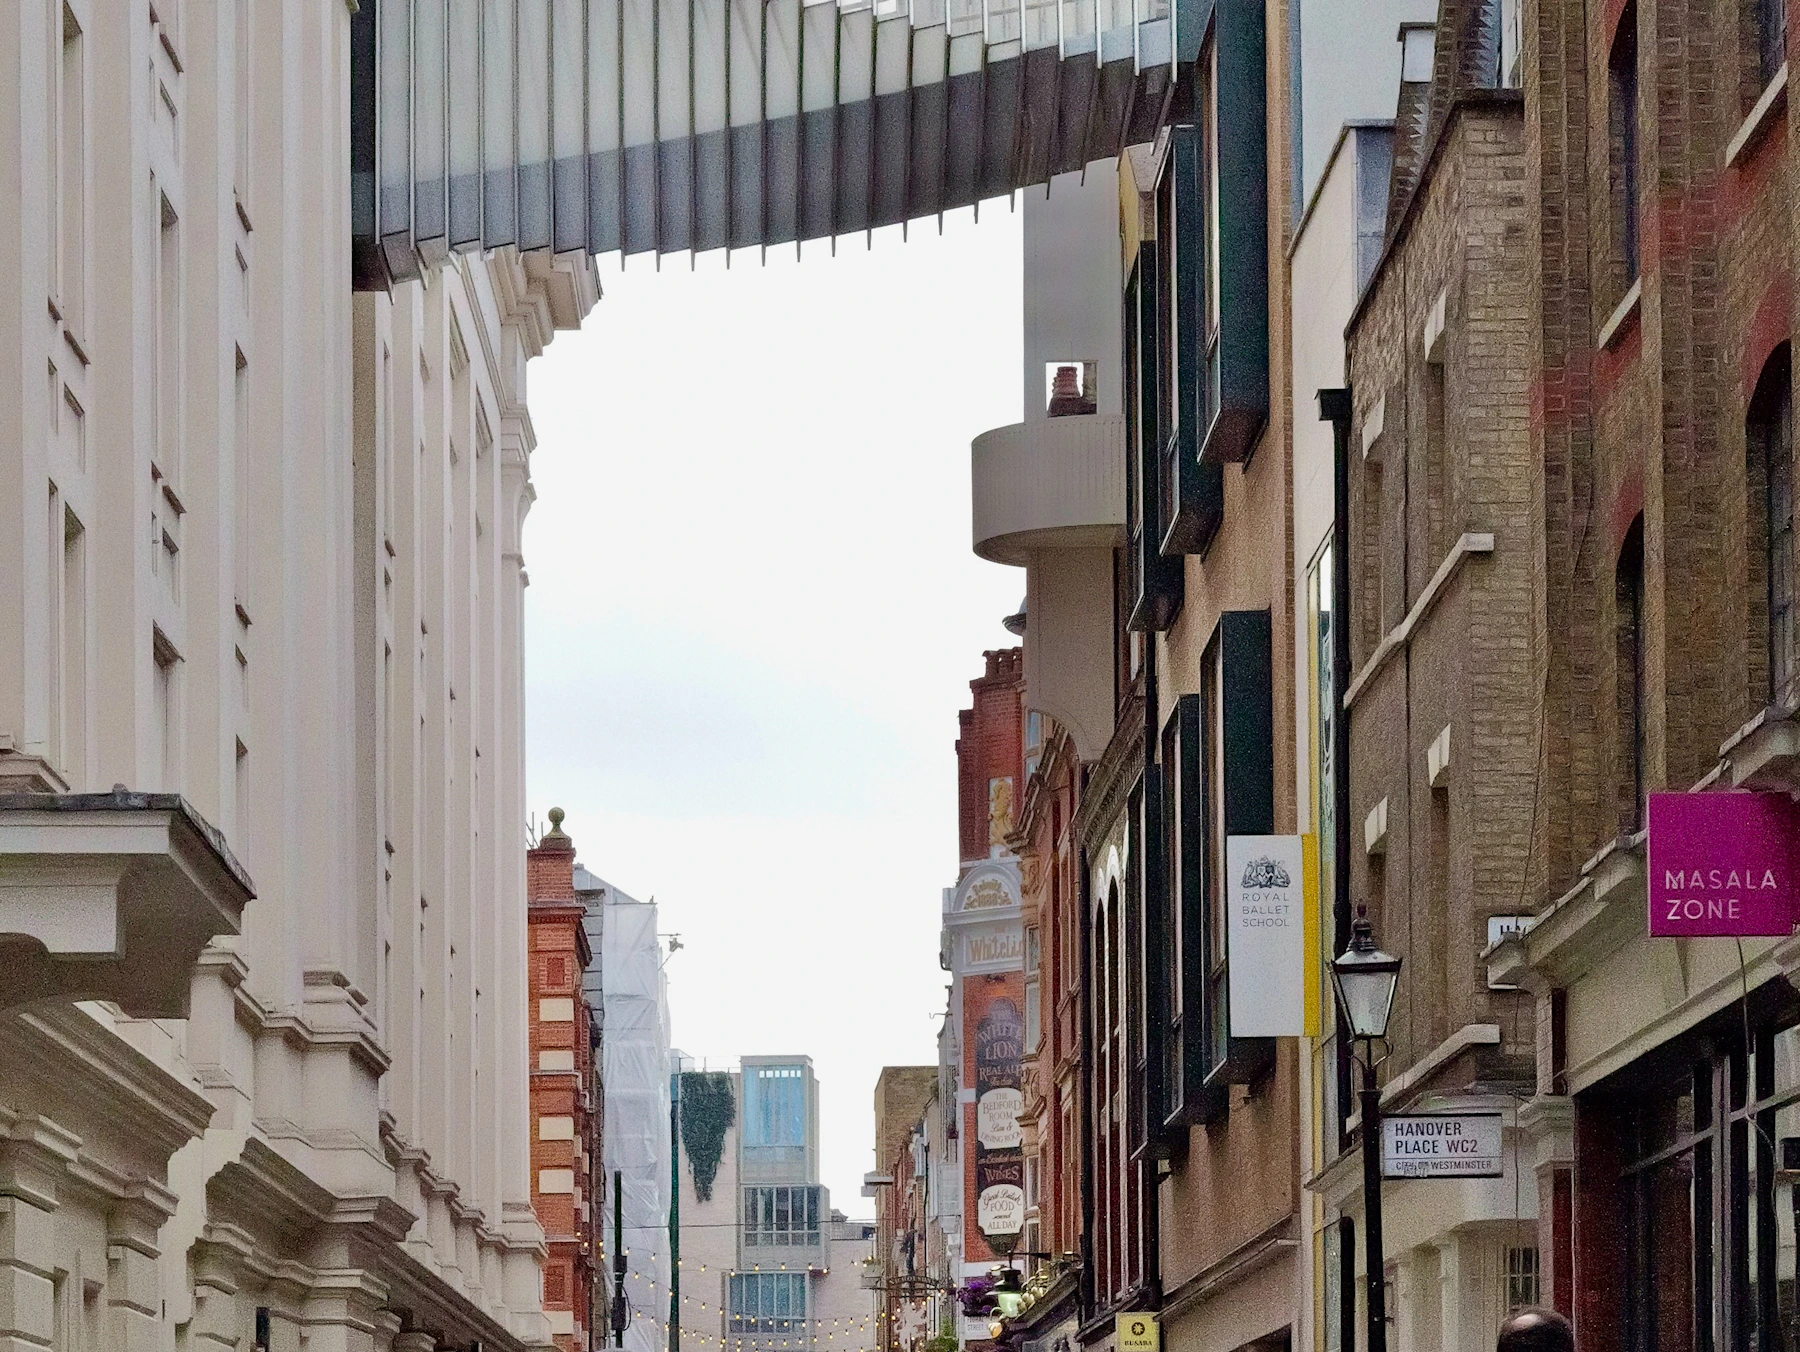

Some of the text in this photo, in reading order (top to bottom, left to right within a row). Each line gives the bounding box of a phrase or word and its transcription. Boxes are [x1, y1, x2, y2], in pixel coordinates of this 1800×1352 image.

[1664, 869, 1777, 890] MASALA
[1242, 892, 1290, 902] ROYAL
[1242, 905, 1290, 915] BALLET
[1666, 899, 1741, 920] ZONE
[1242, 918, 1290, 928] SCHOOL
[979, 1022, 1022, 1043] WHITE
[985, 1041, 1018, 1060] LION
[980, 1066, 1003, 1082] REAL
[993, 1092, 1008, 1100] THE
[982, 1100, 1021, 1115] BEDFORD
[989, 1111, 1013, 1122] ROOM
[1395, 1122, 1462, 1137] HANOVER
[1395, 1139, 1478, 1154] PLACE WC2
[1430, 1160, 1492, 1171] WESTMINSTER
[983, 1165, 1020, 1183] WINES
[990, 1200, 1015, 1212] FOOD
[987, 1220, 1017, 1230] ALL DAY
